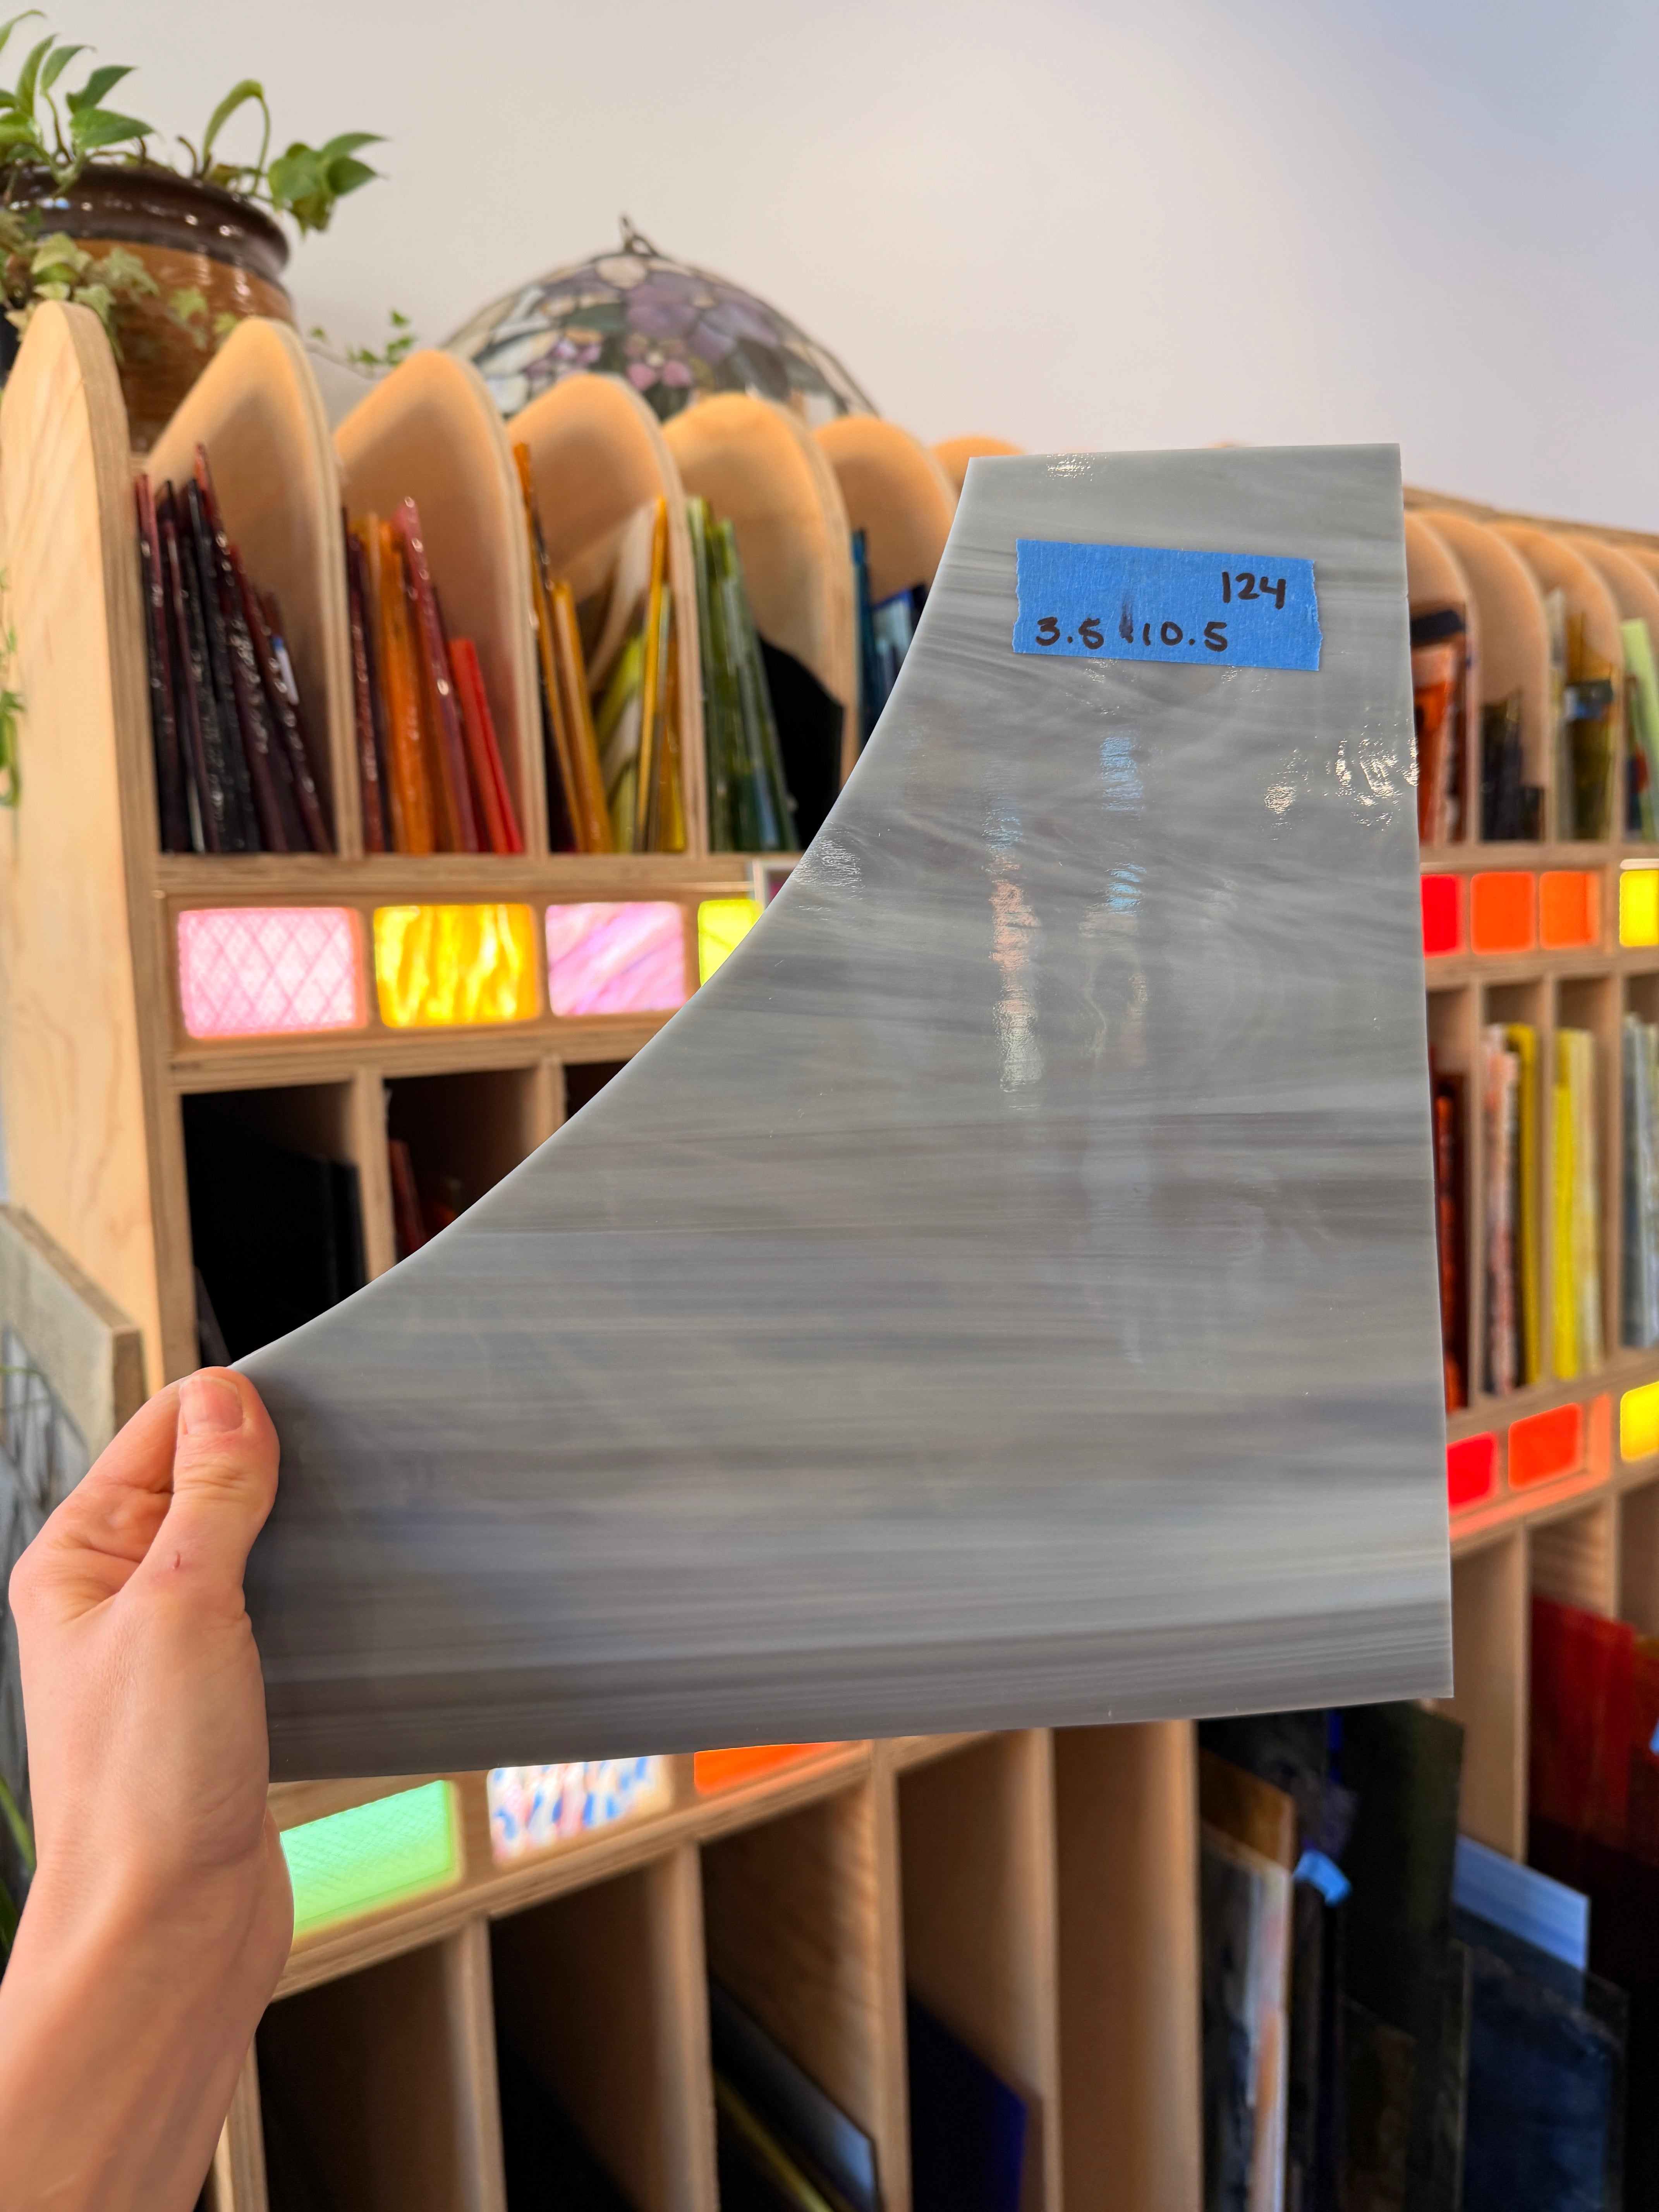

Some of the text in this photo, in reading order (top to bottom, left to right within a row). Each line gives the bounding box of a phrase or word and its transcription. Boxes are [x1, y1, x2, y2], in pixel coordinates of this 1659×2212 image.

[1222, 571, 1286, 610] 124
[1035, 617, 1104, 650] 3.5
[1143, 621, 1228, 652] 10.5
